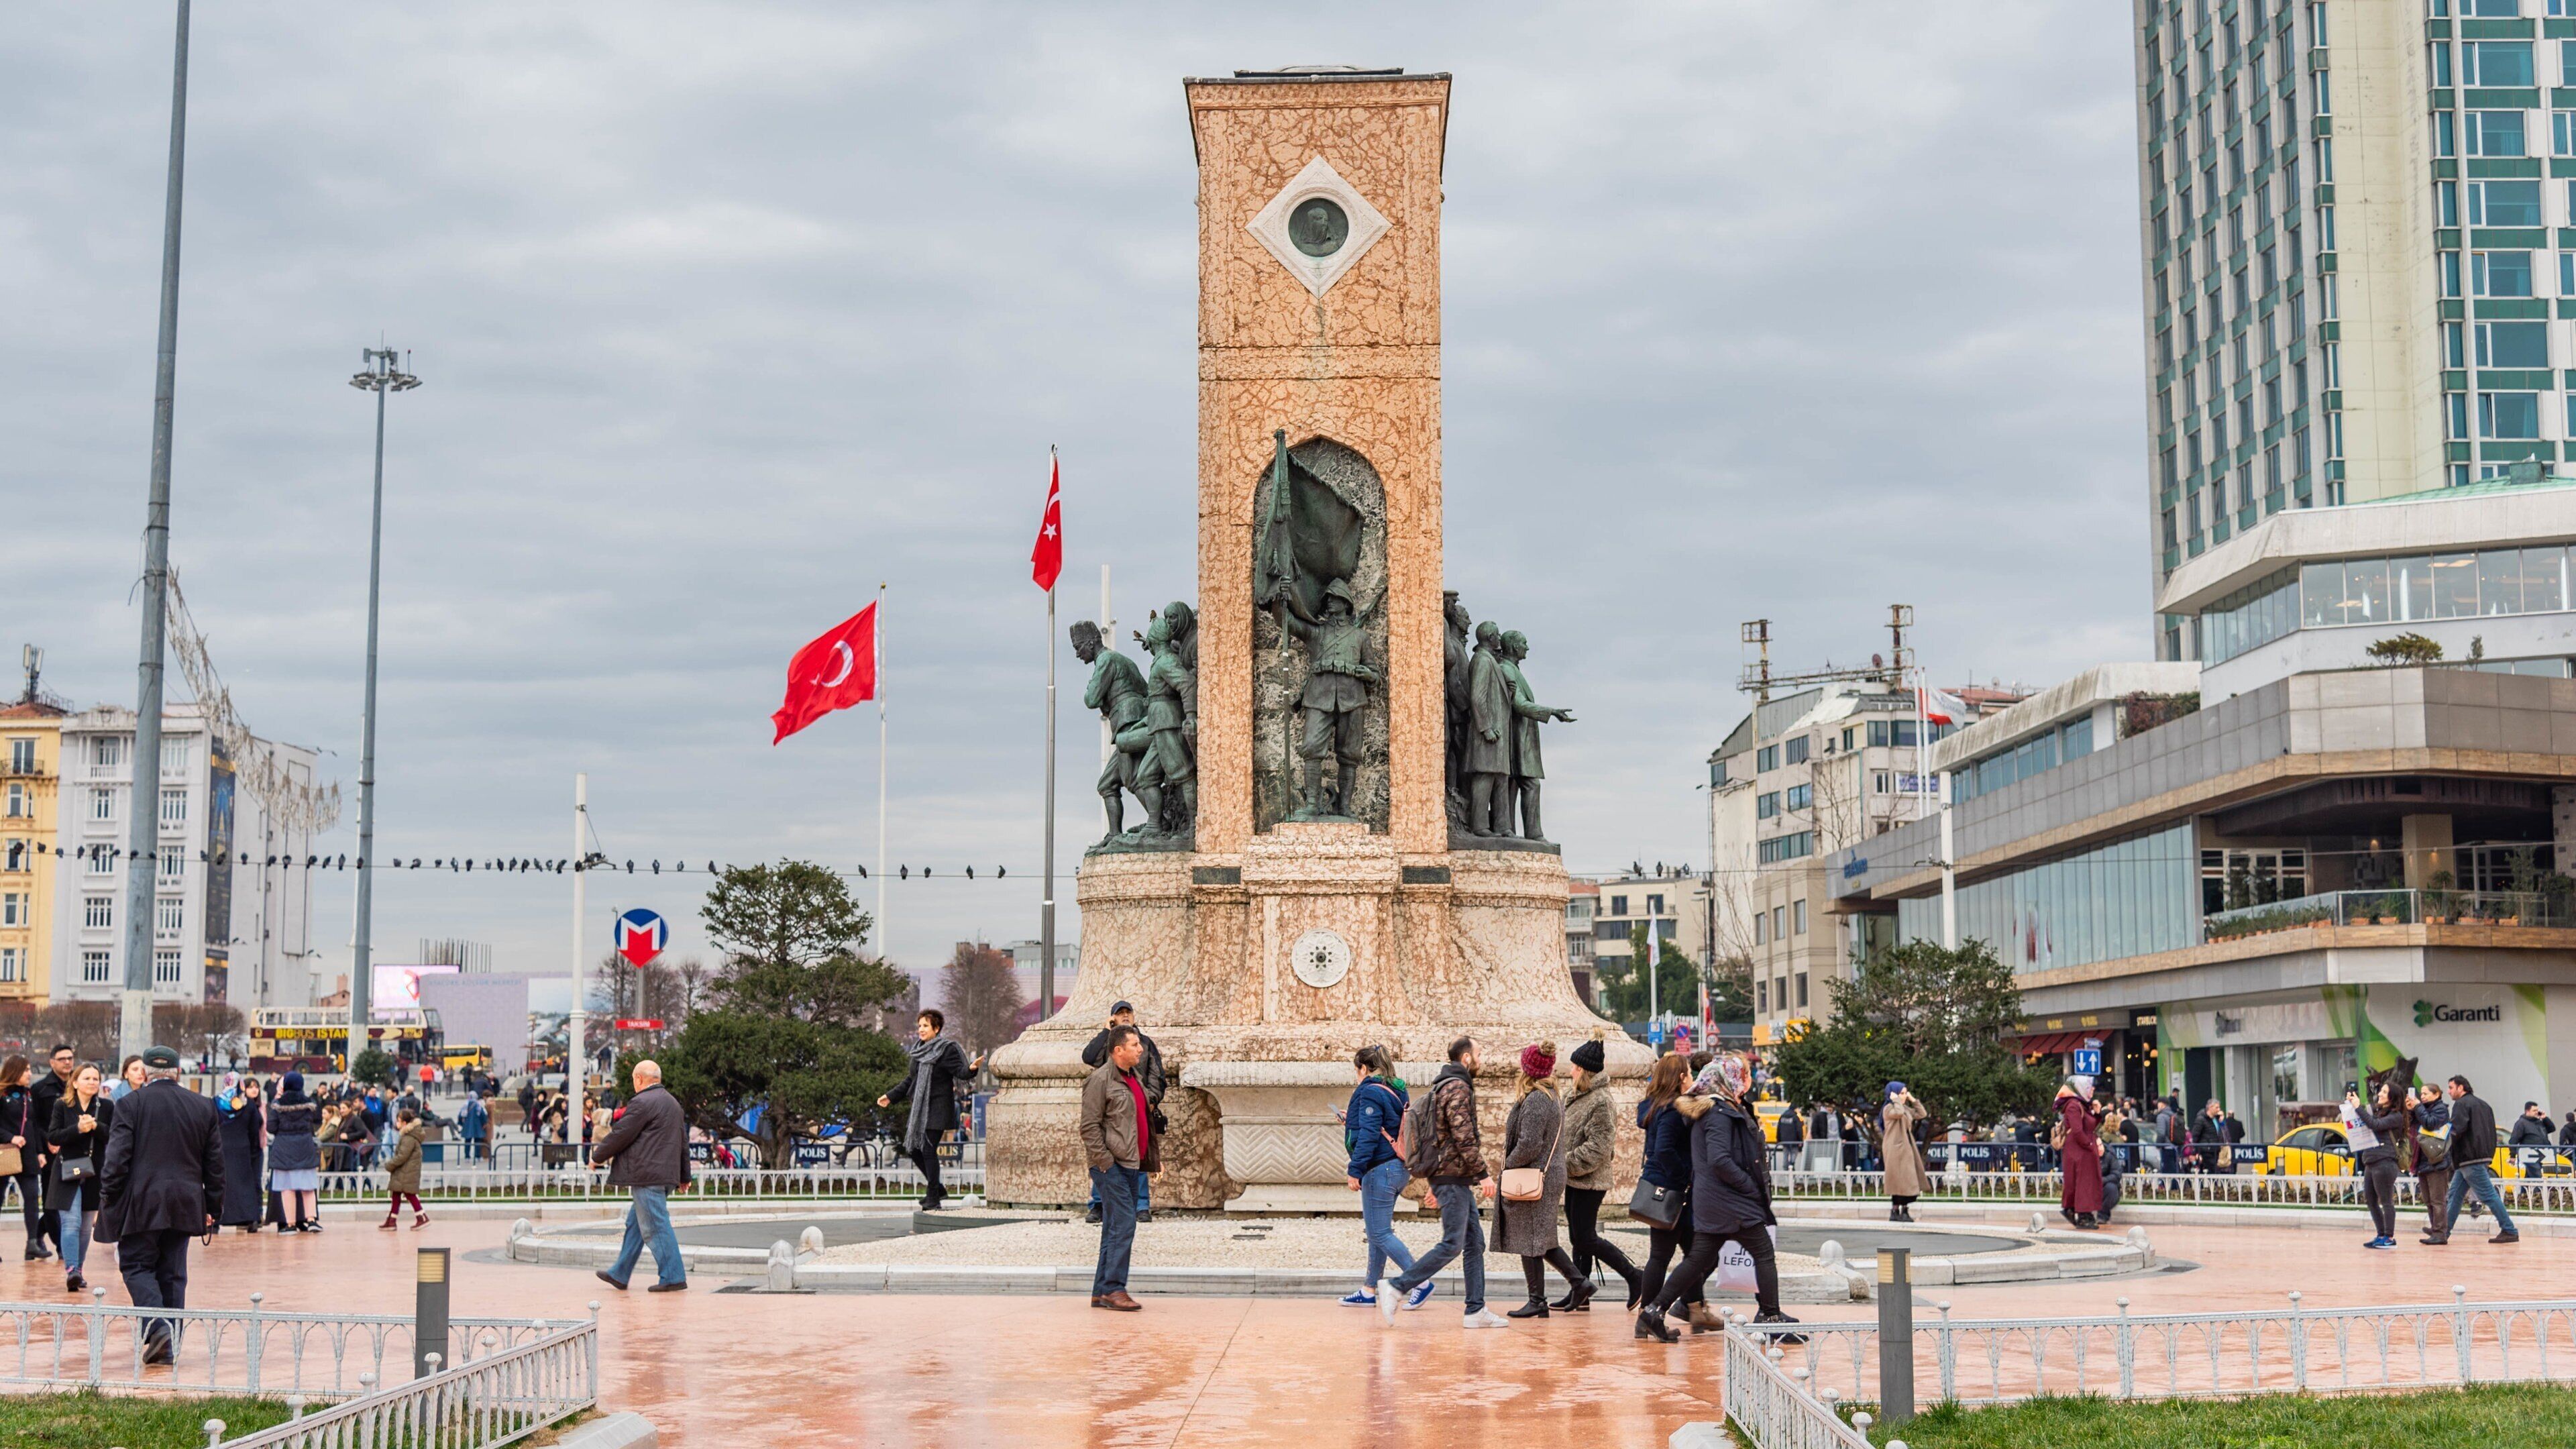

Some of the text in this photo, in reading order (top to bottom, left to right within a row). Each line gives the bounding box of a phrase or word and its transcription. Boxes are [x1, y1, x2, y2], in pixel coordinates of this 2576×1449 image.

[2434, 1004, 2500, 1022] Garanti
[317, 1028, 349, 1038] ISTAN
[1961, 1146, 1990, 1158] POLİS
[2235, 1146, 2264, 1159] POLİS
[1723, 1256, 1756, 1267] LEFO
